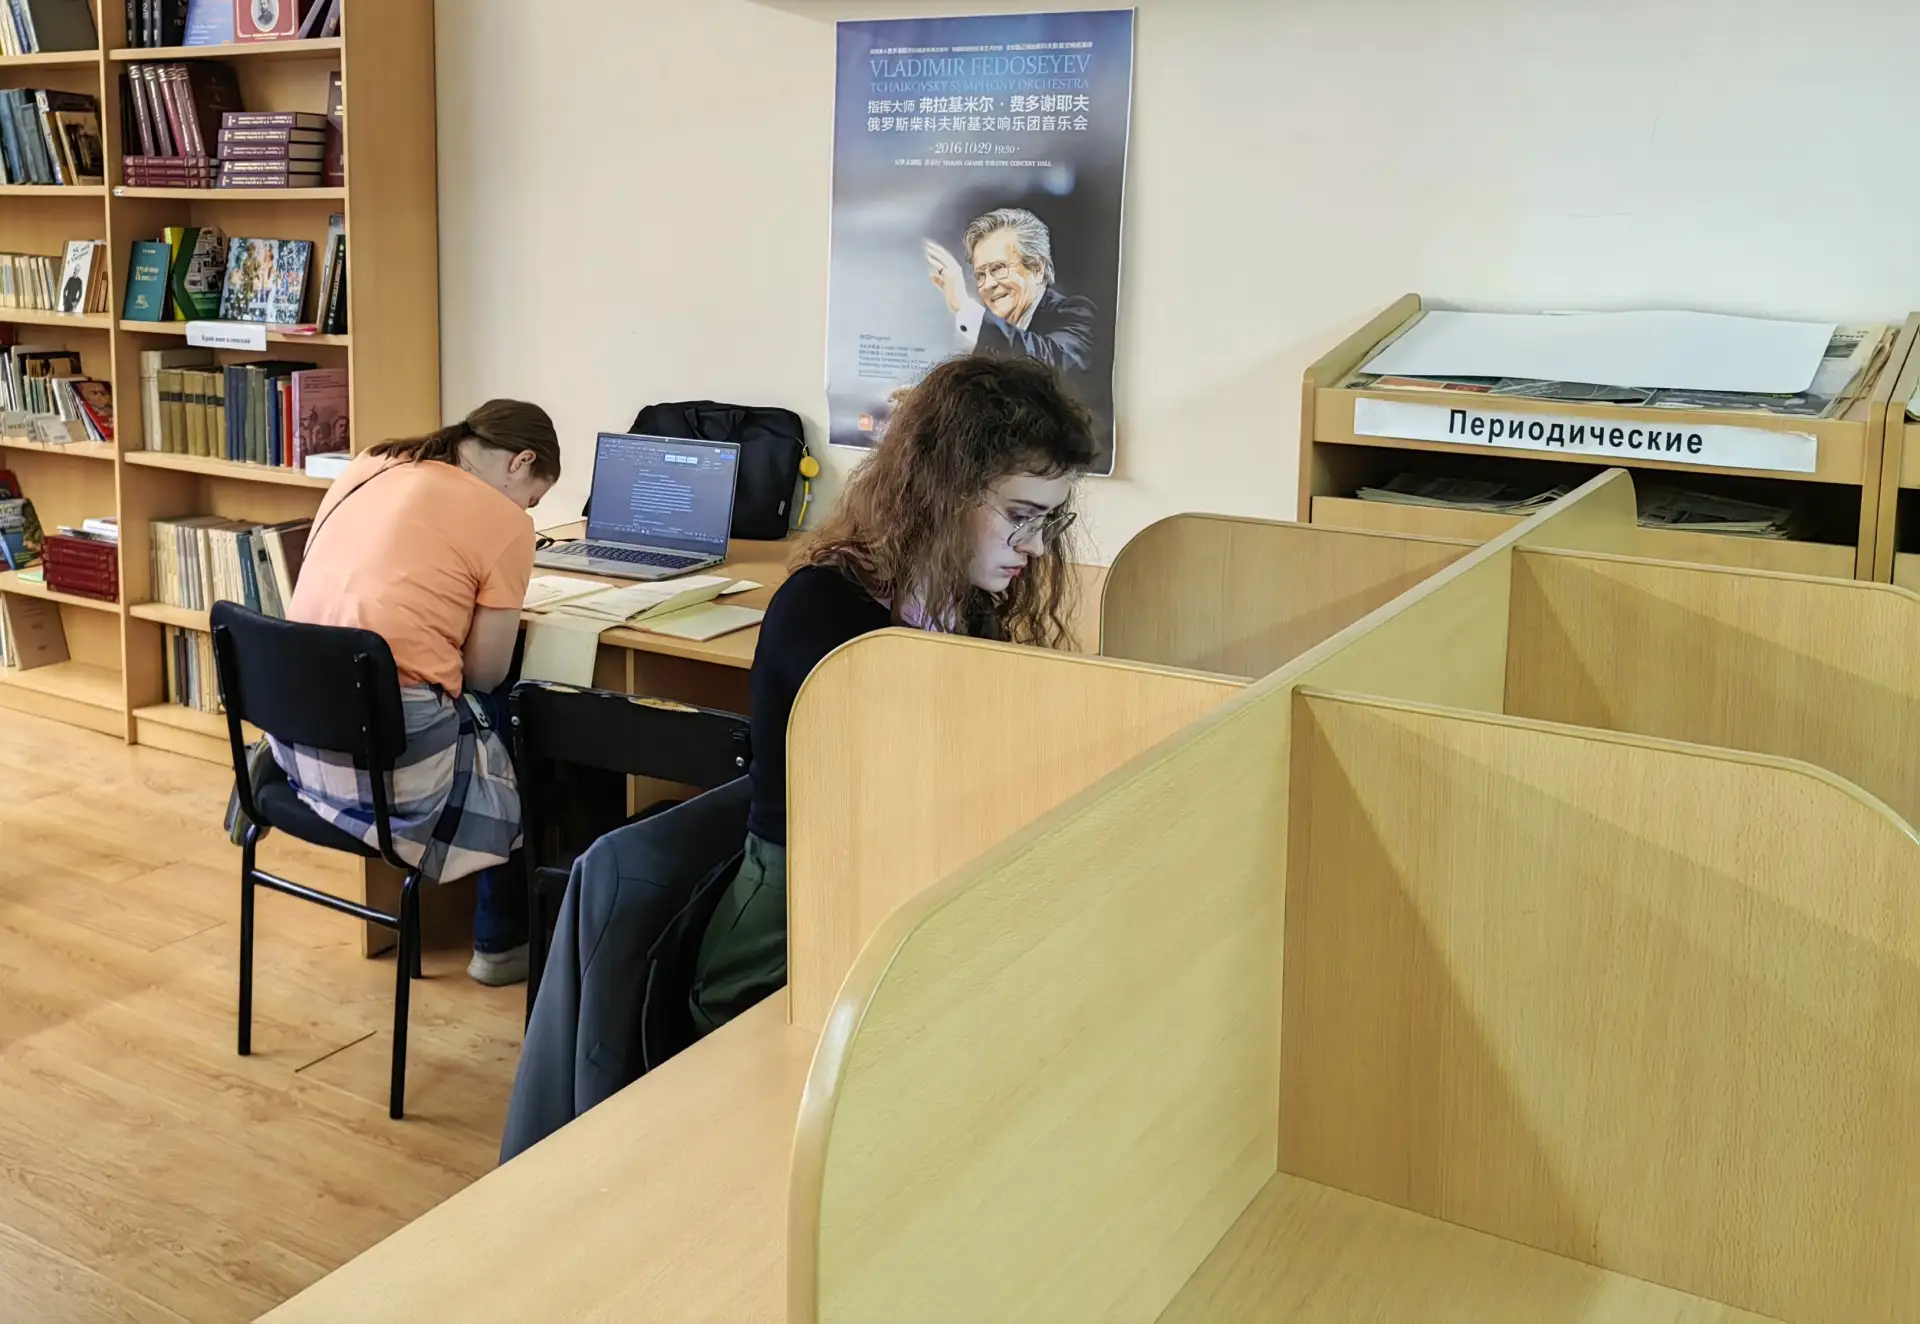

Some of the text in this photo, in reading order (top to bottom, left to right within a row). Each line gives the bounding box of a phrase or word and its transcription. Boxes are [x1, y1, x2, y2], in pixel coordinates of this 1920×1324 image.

[870, 54, 1092, 78] VLADIMIR FEDOSEYEV
[870, 77, 1089, 94] TCHAIKOVSKY SYMPHONY ORCHESTRA
[867, 99, 915, 114] 指挥大师
[867, 115, 1088, 132] 俄罗斯柴科夫斯基交响乐团音乐会
[1449, 409, 1703, 454] Периодические
